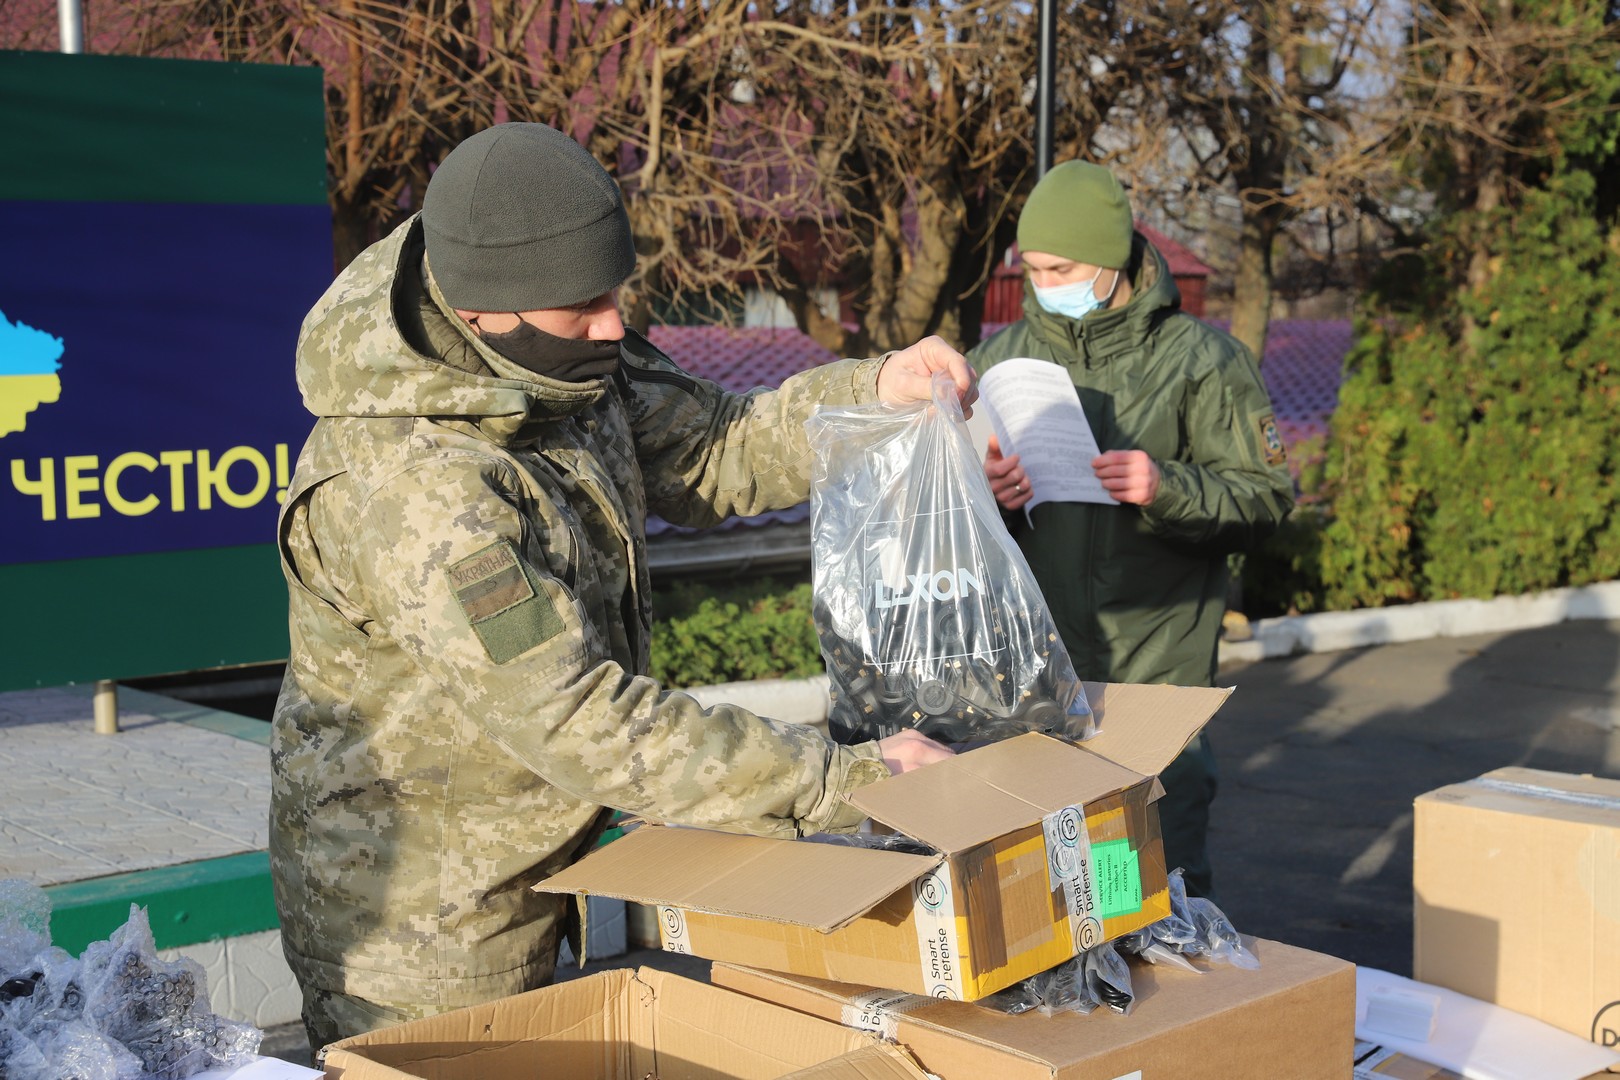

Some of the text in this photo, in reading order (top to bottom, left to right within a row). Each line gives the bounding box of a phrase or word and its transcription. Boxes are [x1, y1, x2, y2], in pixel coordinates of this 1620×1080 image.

[11, 443, 289, 521] ЧЕСТЮ!
[1072, 875, 1084, 916] Smart
[1081, 859, 1094, 911] Defense
[928, 938, 940, 979] Smart
[938, 928, 953, 981] Defense
